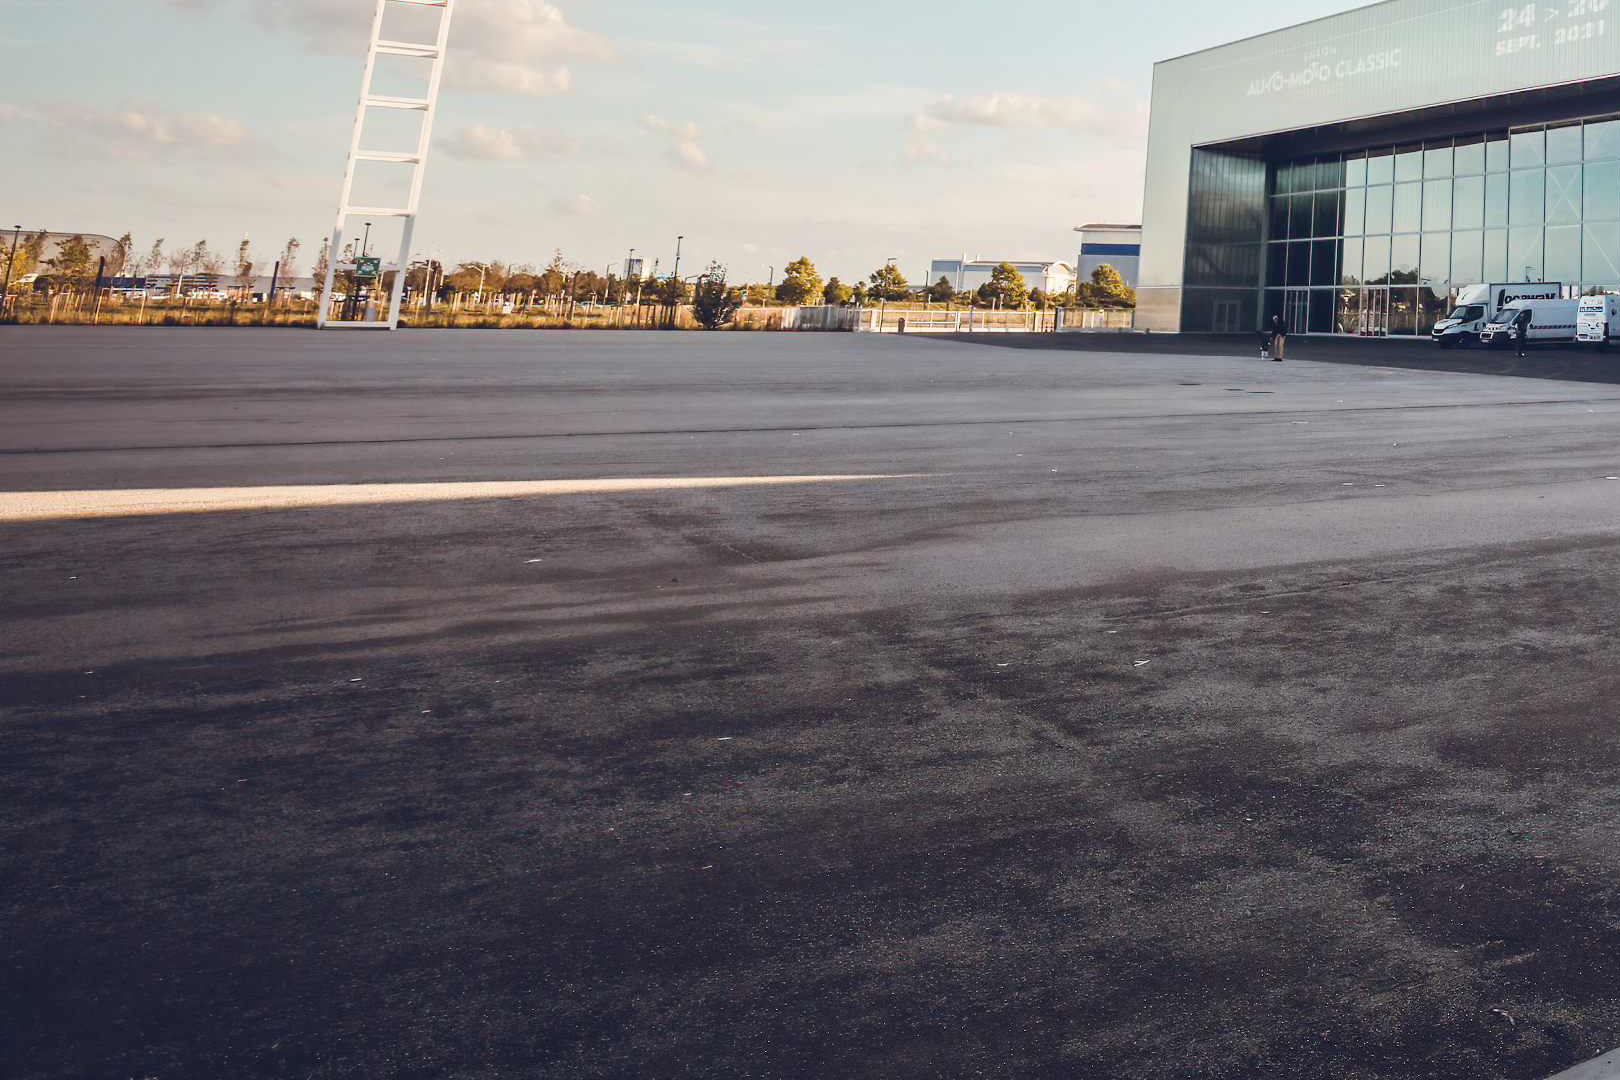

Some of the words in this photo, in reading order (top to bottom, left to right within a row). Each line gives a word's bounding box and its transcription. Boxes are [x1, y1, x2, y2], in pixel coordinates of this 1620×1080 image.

[1496, 3, 1536, 33] 24
[1495, 34, 1541, 57] SEPT.
[1553, 19, 1604, 45] 2021
[1336, 48, 1403, 78] CLASSIC
